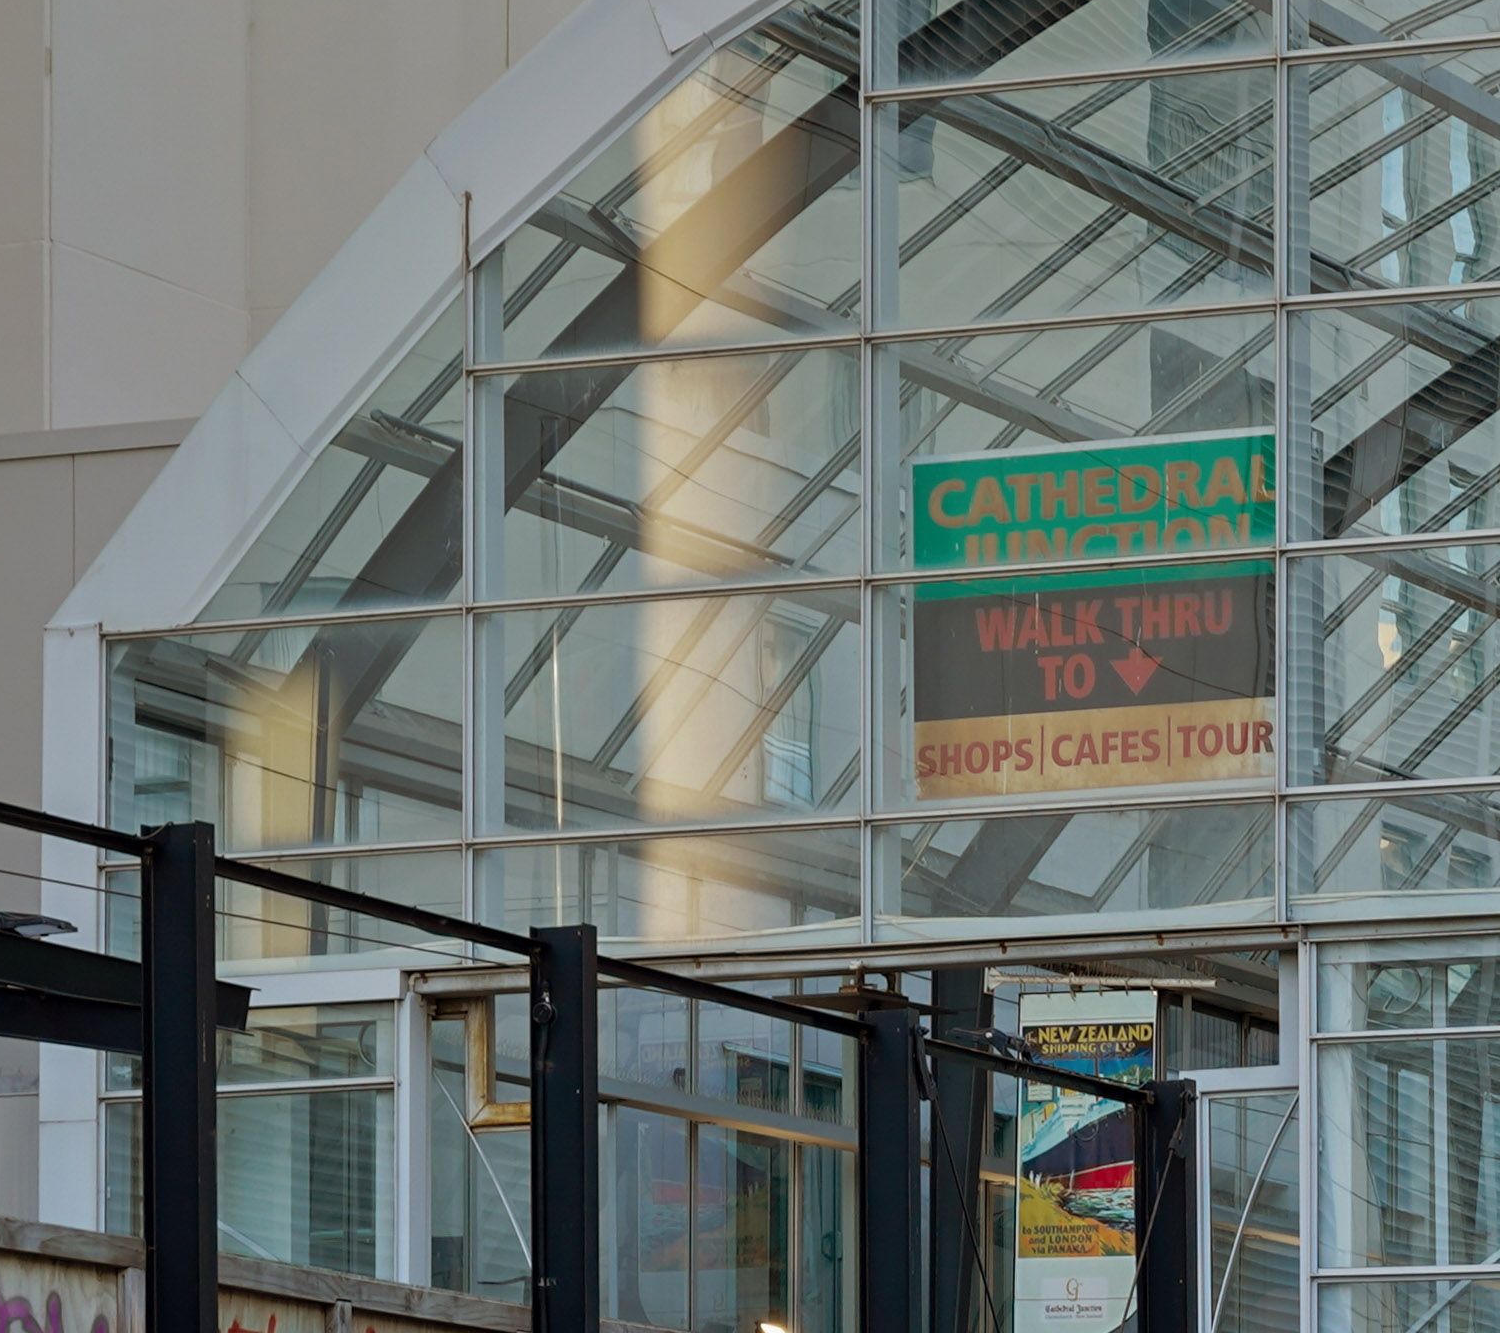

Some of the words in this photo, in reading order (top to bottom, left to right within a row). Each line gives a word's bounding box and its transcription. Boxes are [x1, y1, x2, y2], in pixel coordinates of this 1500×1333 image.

[928, 455, 1276, 528] CATHEDRAL
[976, 600, 1105, 652] WALK
[1115, 589, 1234, 641] THRU
[1037, 654, 1097, 701] TO
[917, 738, 1035, 778] SHOPS
[1051, 727, 1162, 767] CAFES
[1177, 721, 1274, 758] TOUR
[1038, 1026, 1075, 1044] NEW
[1077, 1024, 1153, 1042] ZEALAND
[1041, 1042, 1097, 1054] SHIPPING
[1034, 1224, 1100, 1234] SOUTHAMPTON
[1049, 1234, 1092, 1244] LONDON
